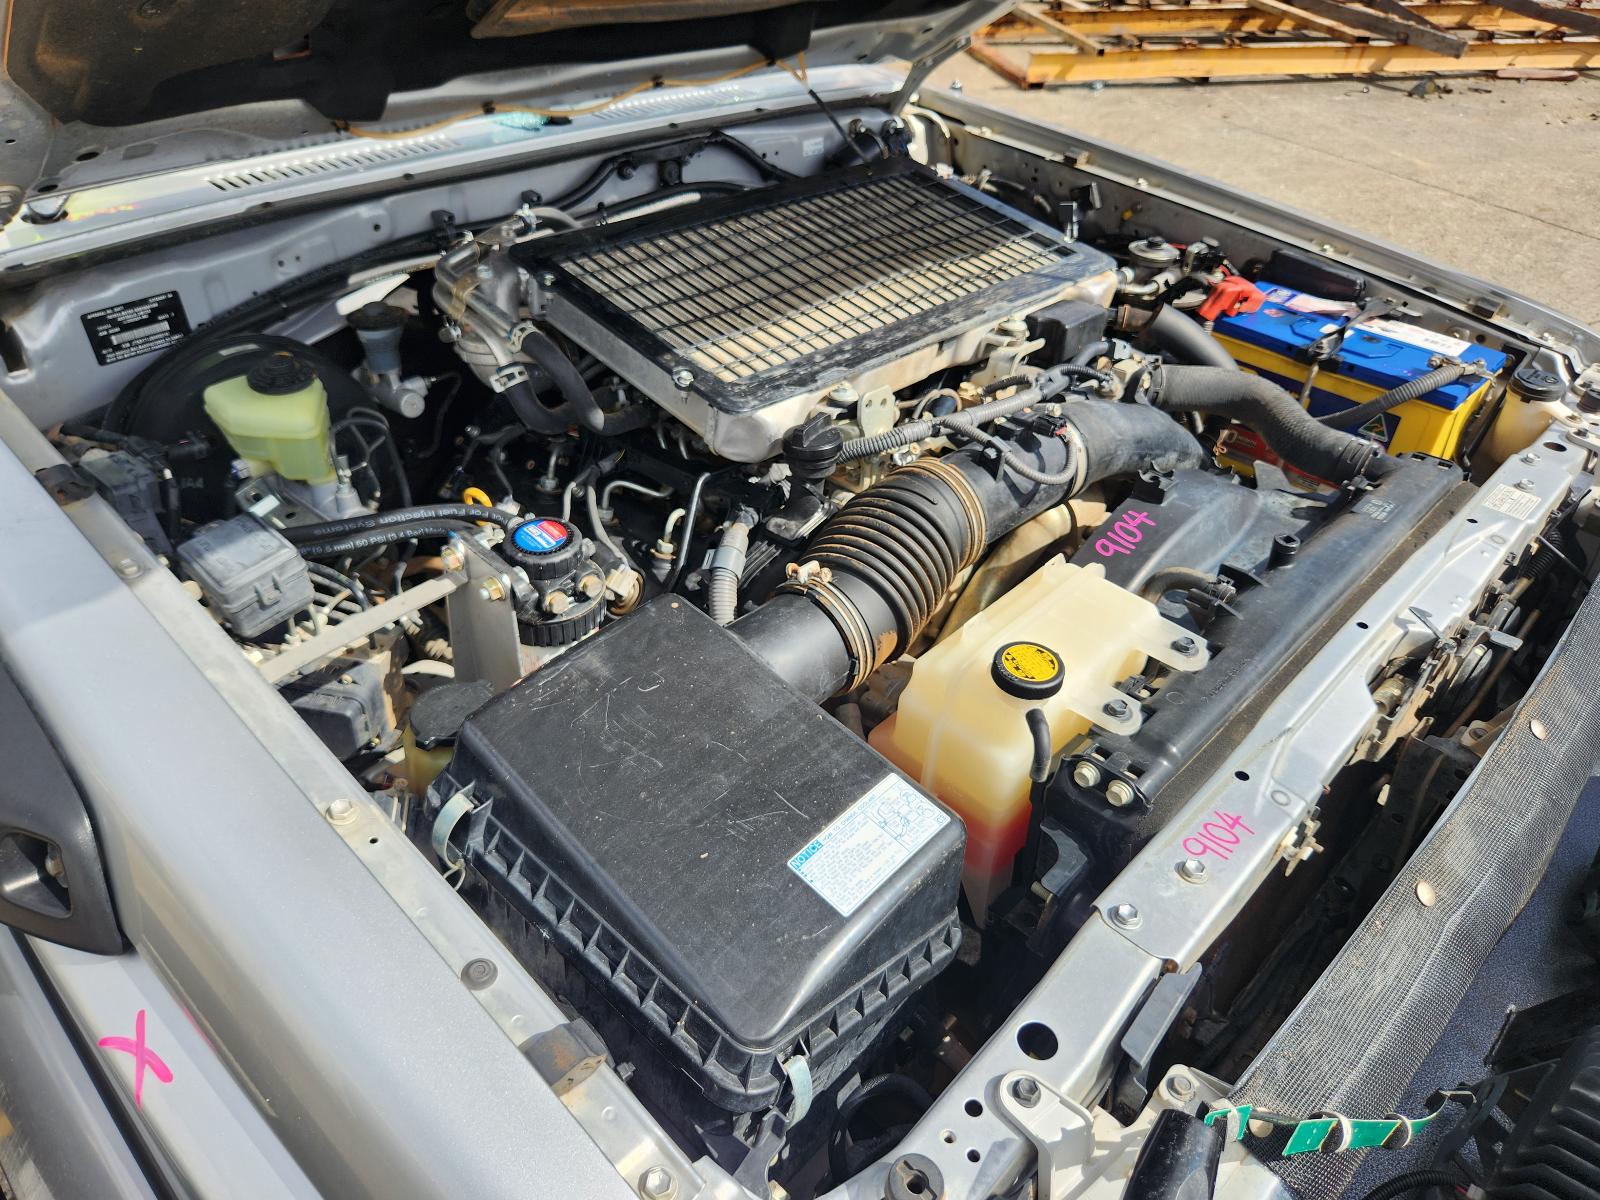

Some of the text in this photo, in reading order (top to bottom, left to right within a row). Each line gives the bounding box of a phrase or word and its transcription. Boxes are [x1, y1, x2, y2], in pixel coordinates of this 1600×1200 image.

[380, 508, 436, 524] Injection
[440, 507, 466, 517] Fuel
[470, 508, 489, 518] For
[313, 519, 376, 534] Systems
[1095, 510, 1157, 557] 9104
[356, 538, 368, 548] 50
[370, 535, 386, 544] PSI
[1183, 810, 1255, 860] 9104
[790, 839, 823, 868] NOTICE
